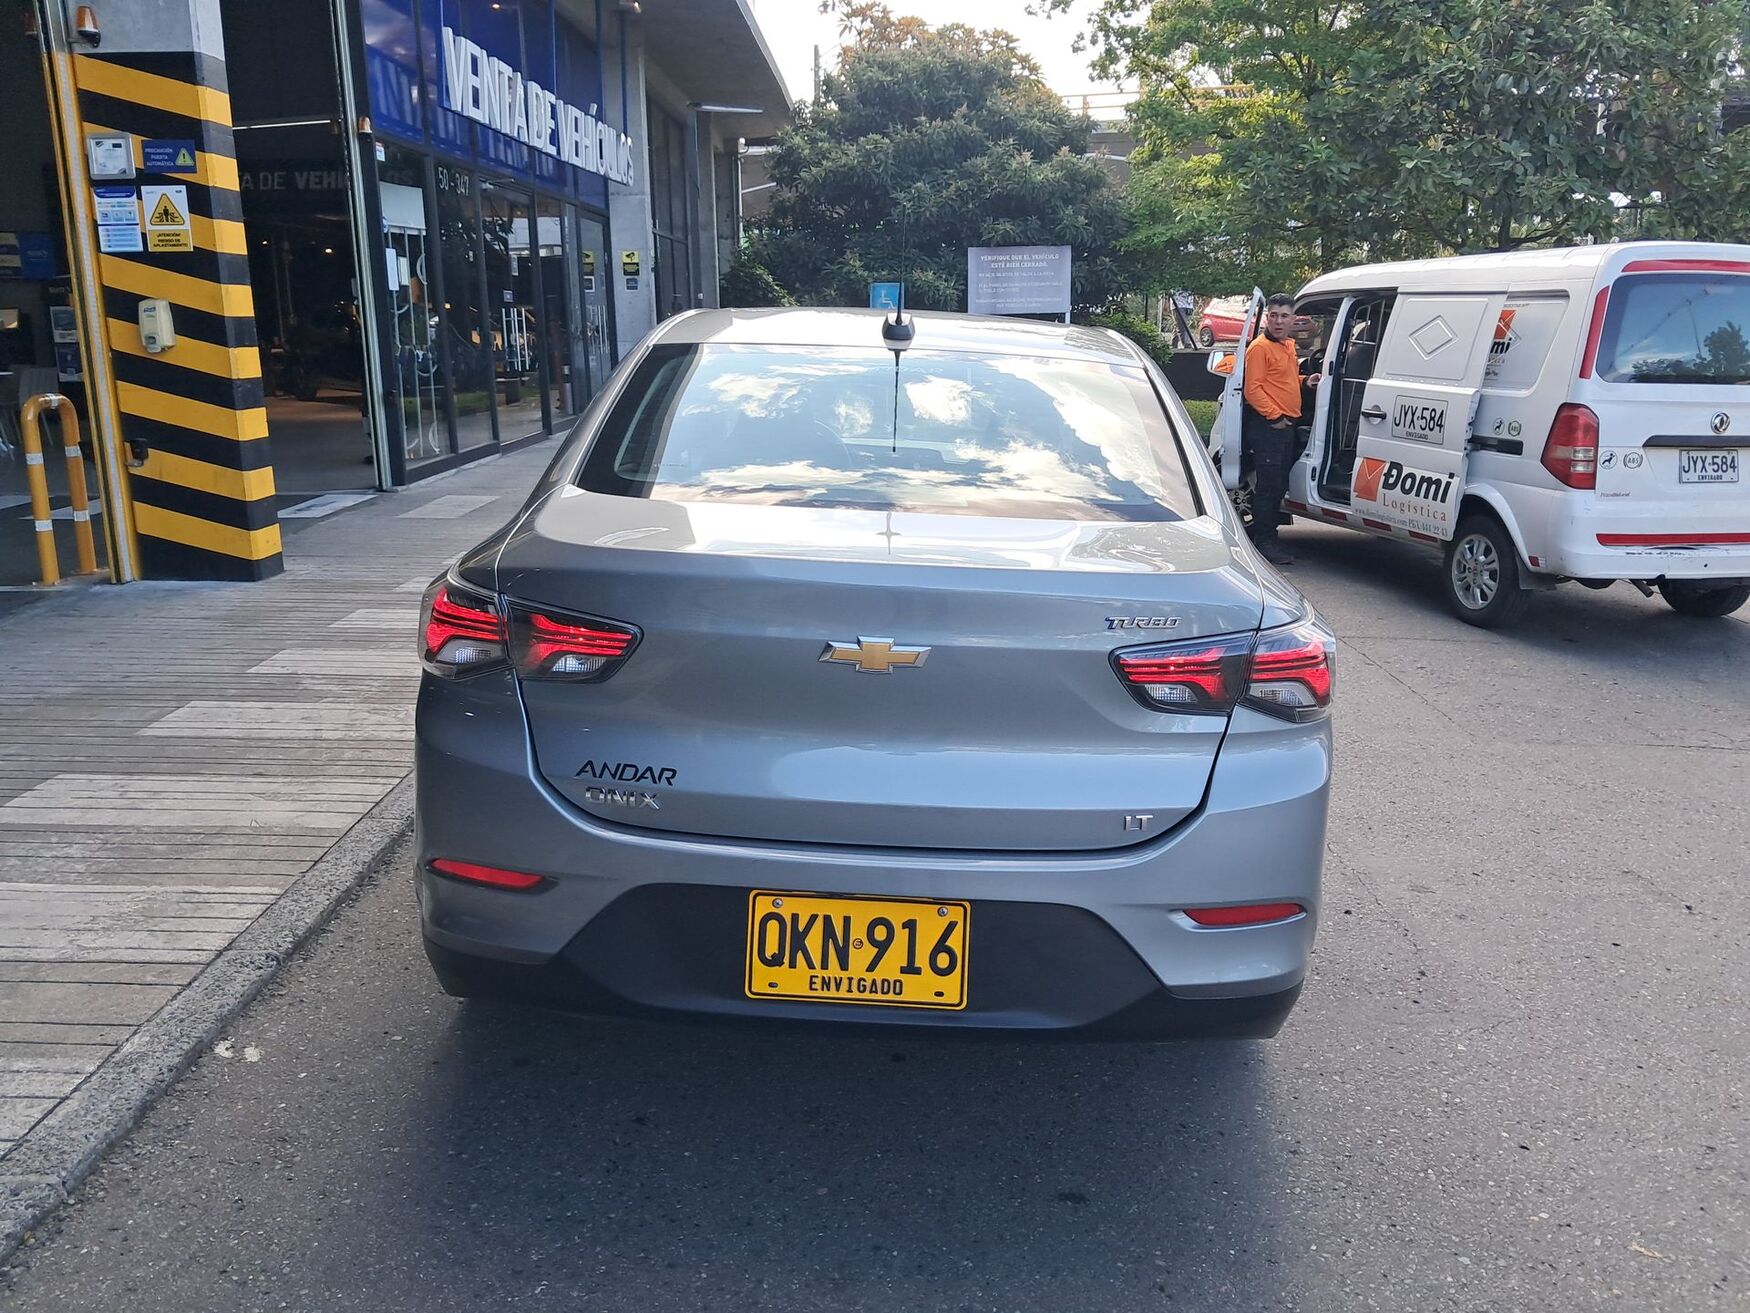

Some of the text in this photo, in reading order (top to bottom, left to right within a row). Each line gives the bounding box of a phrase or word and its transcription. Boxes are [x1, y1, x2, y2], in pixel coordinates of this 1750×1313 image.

[442, 26, 633, 186] VENTA DE VEHÍCULOS
[259, 171, 287, 190] DE
[1382, 493, 1447, 522] Logística
[1104, 615, 1182, 630] TURBO
[575, 760, 677, 786] ANDAR
[585, 786, 660, 810] ONIX
[1123, 815, 1154, 831] LT
[808, 974, 904, 996] ENVIGADO
